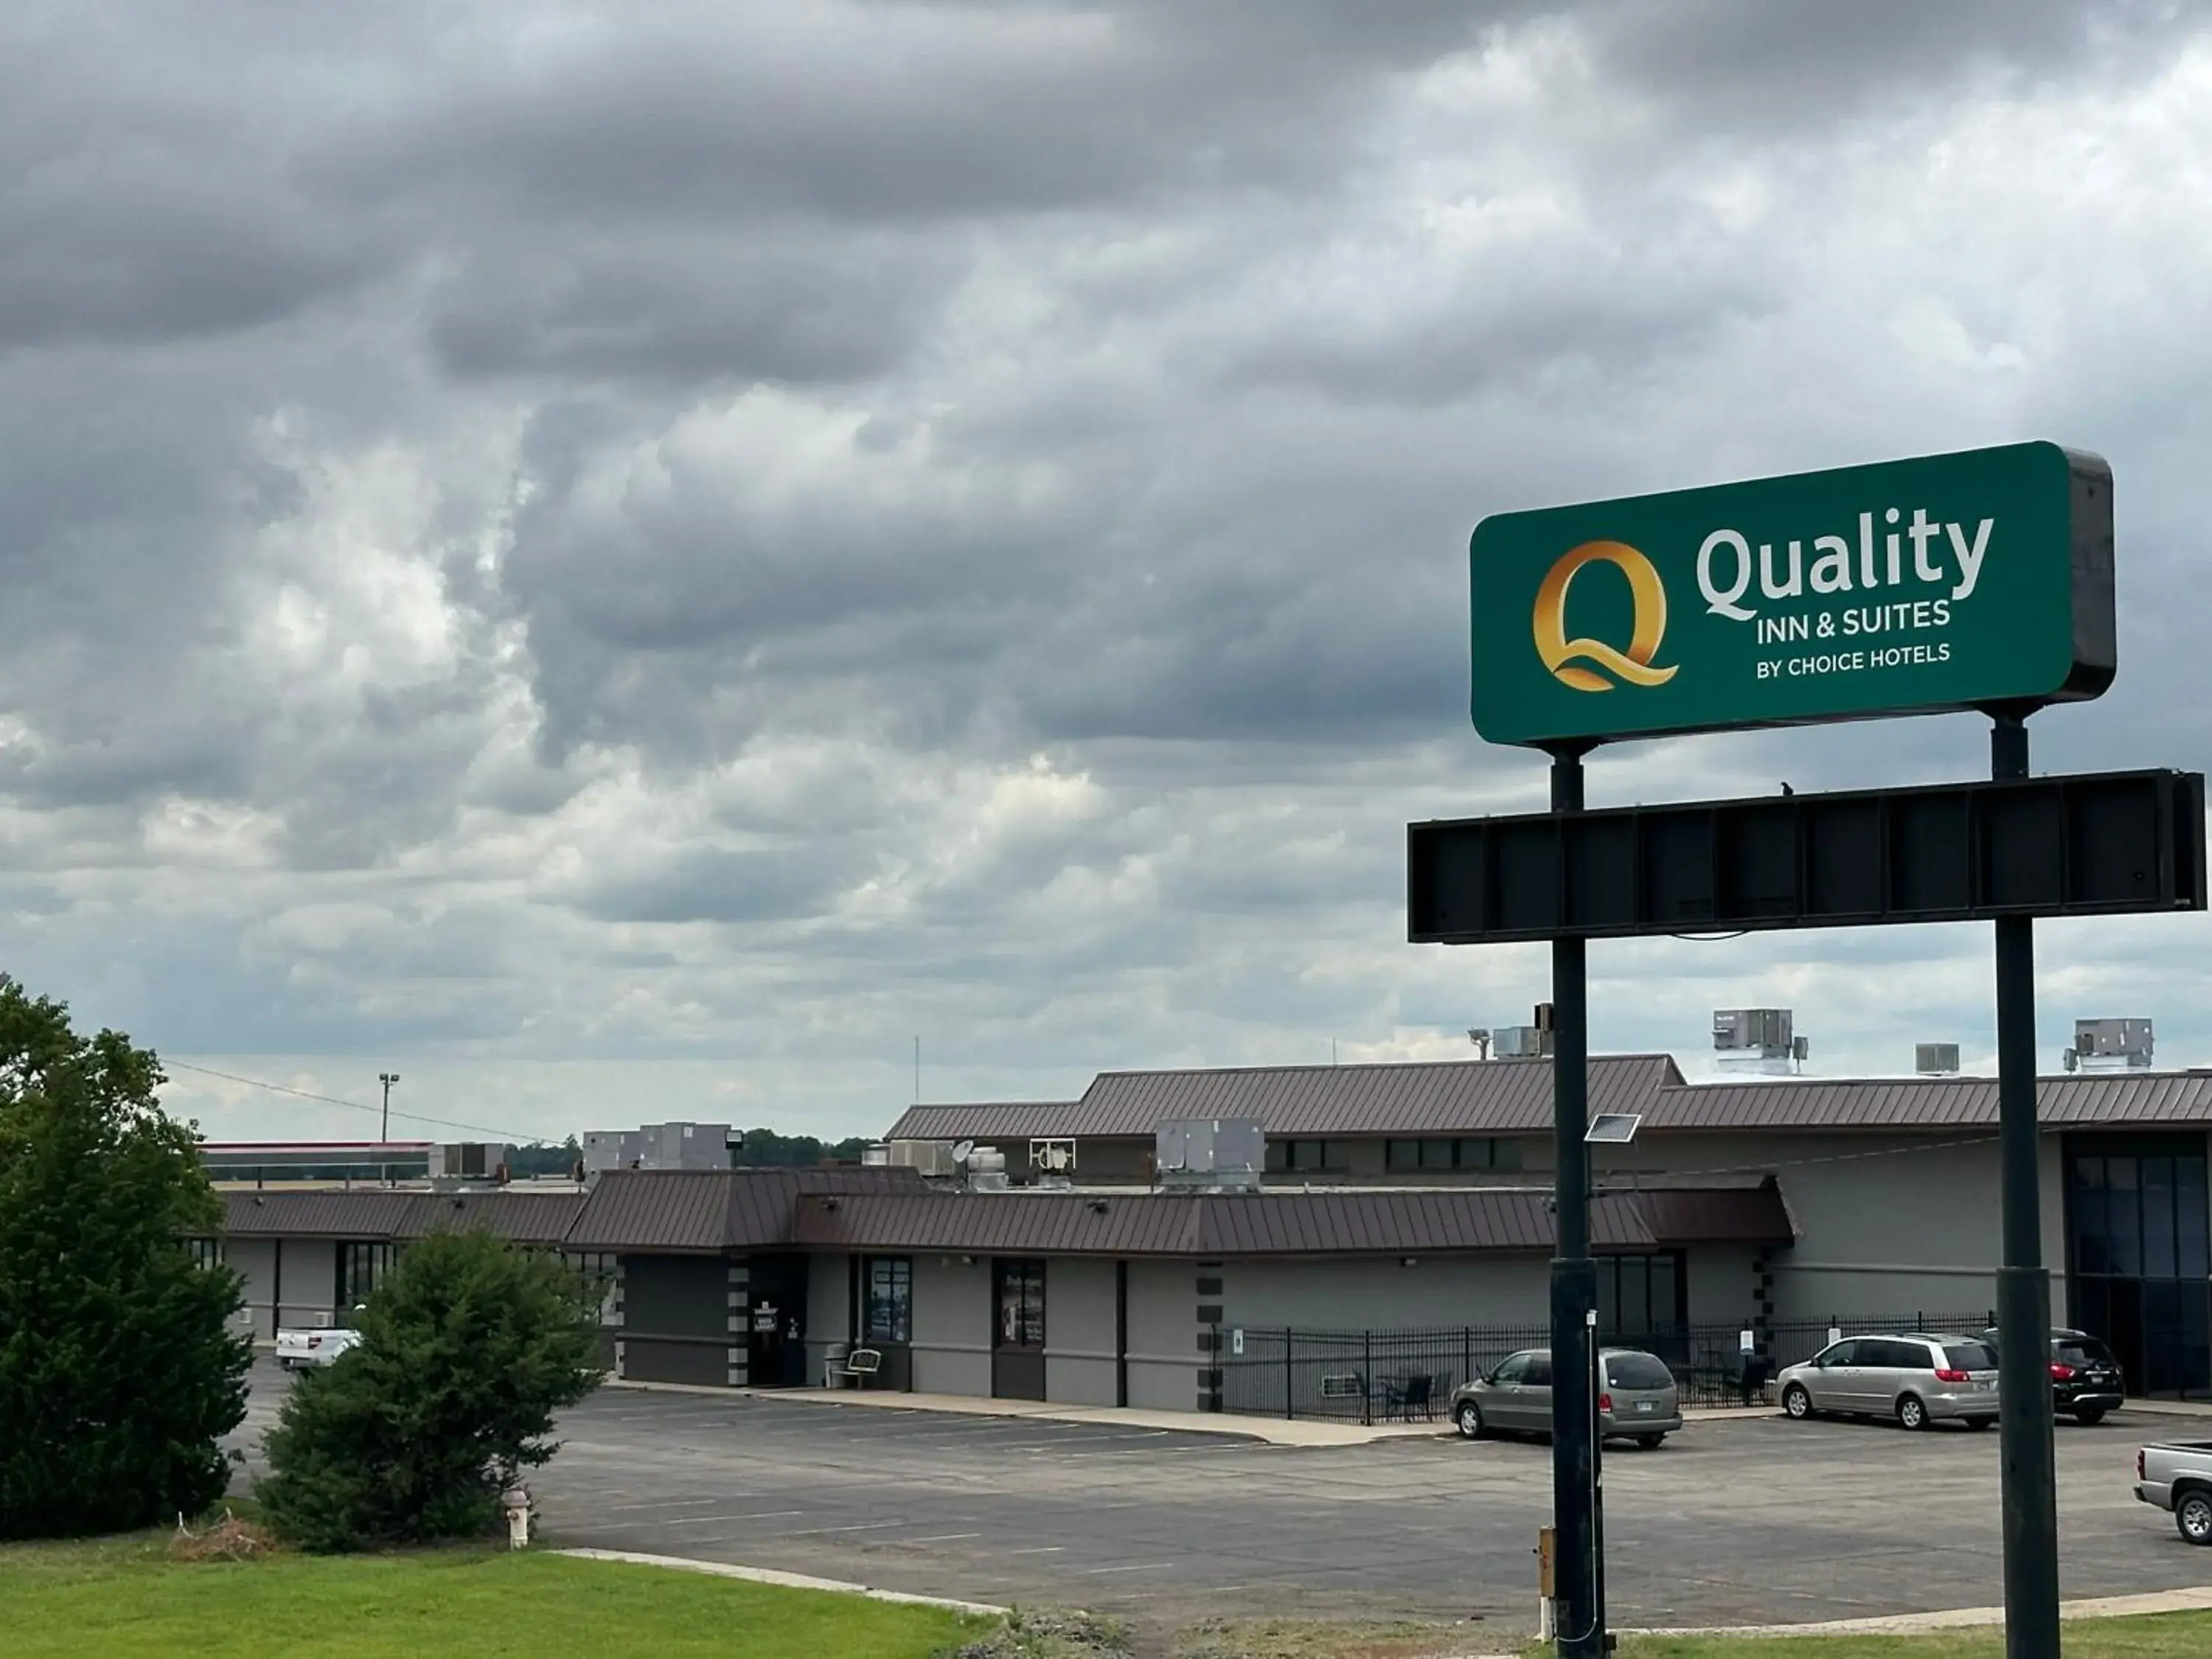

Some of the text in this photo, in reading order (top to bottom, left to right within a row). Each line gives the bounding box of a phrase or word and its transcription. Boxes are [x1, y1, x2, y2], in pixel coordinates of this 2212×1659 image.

[1697, 507, 1994, 621] Quality
[1532, 540, 1680, 692] Q
[1757, 599, 1950, 644] INN & SUITES
[1757, 643, 1950, 679] BY CHOICE HOTELS
